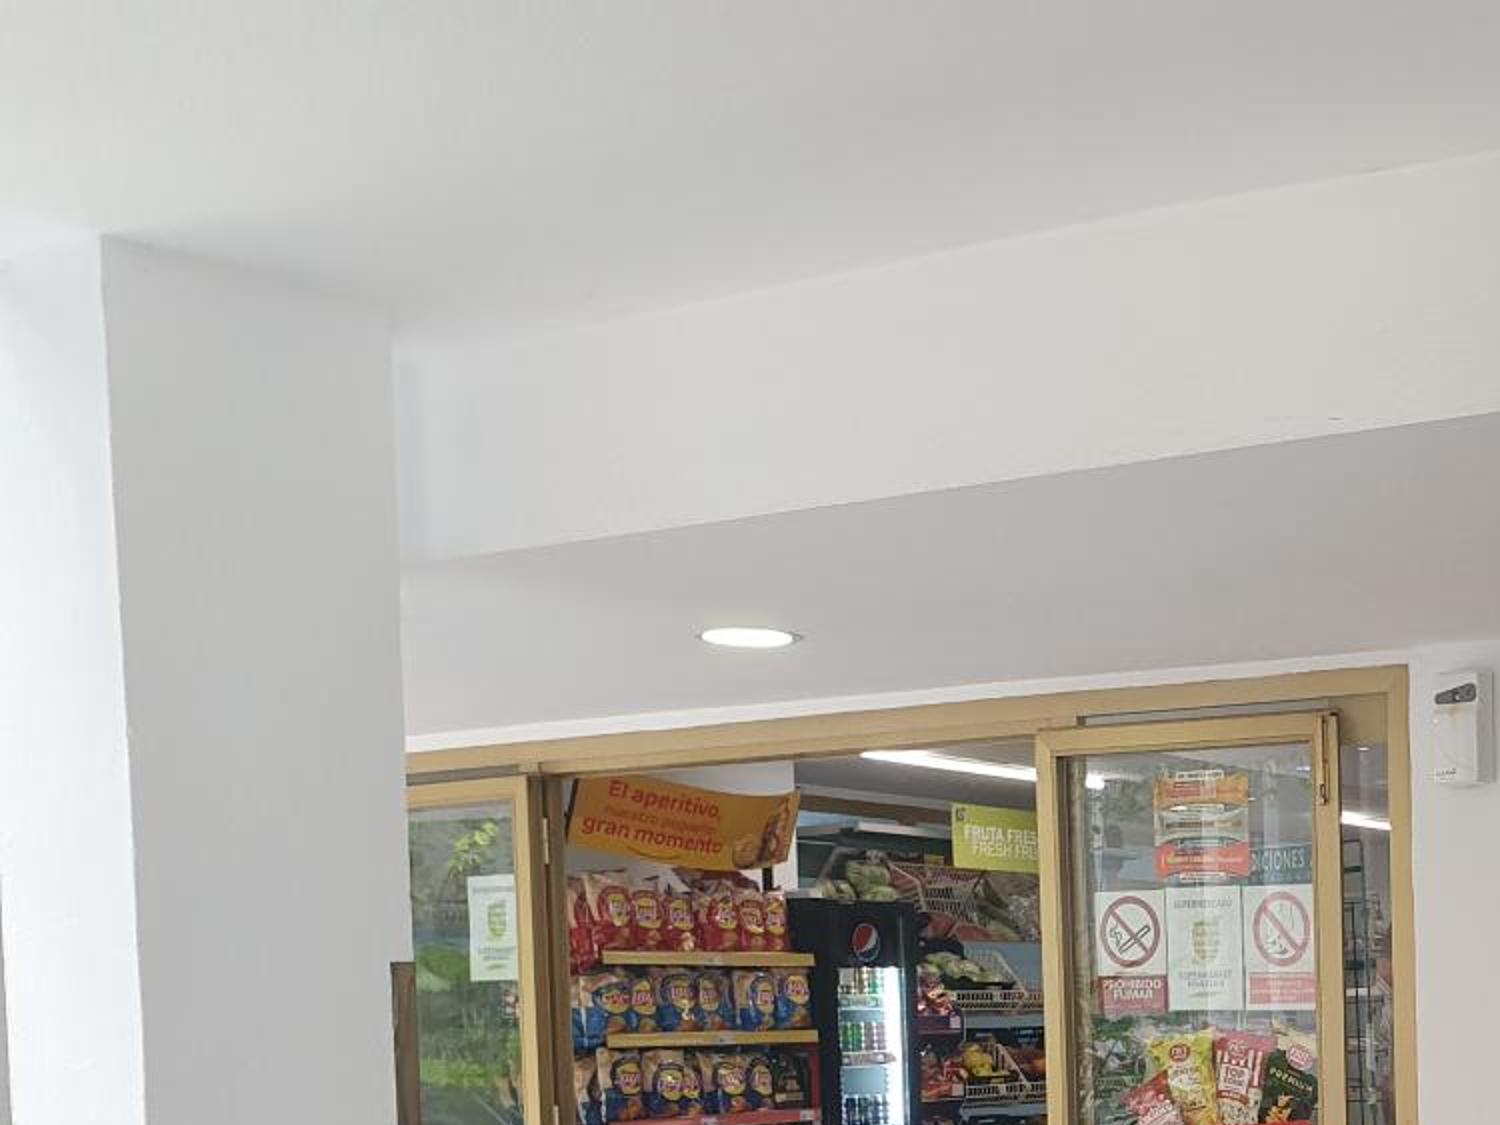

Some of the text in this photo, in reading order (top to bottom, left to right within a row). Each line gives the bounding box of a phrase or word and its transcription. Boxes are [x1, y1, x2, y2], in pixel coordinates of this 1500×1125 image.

[608, 779, 629, 798] El
[582, 816, 723, 854] gran momento
[1007, 828, 1038, 846] FRES
